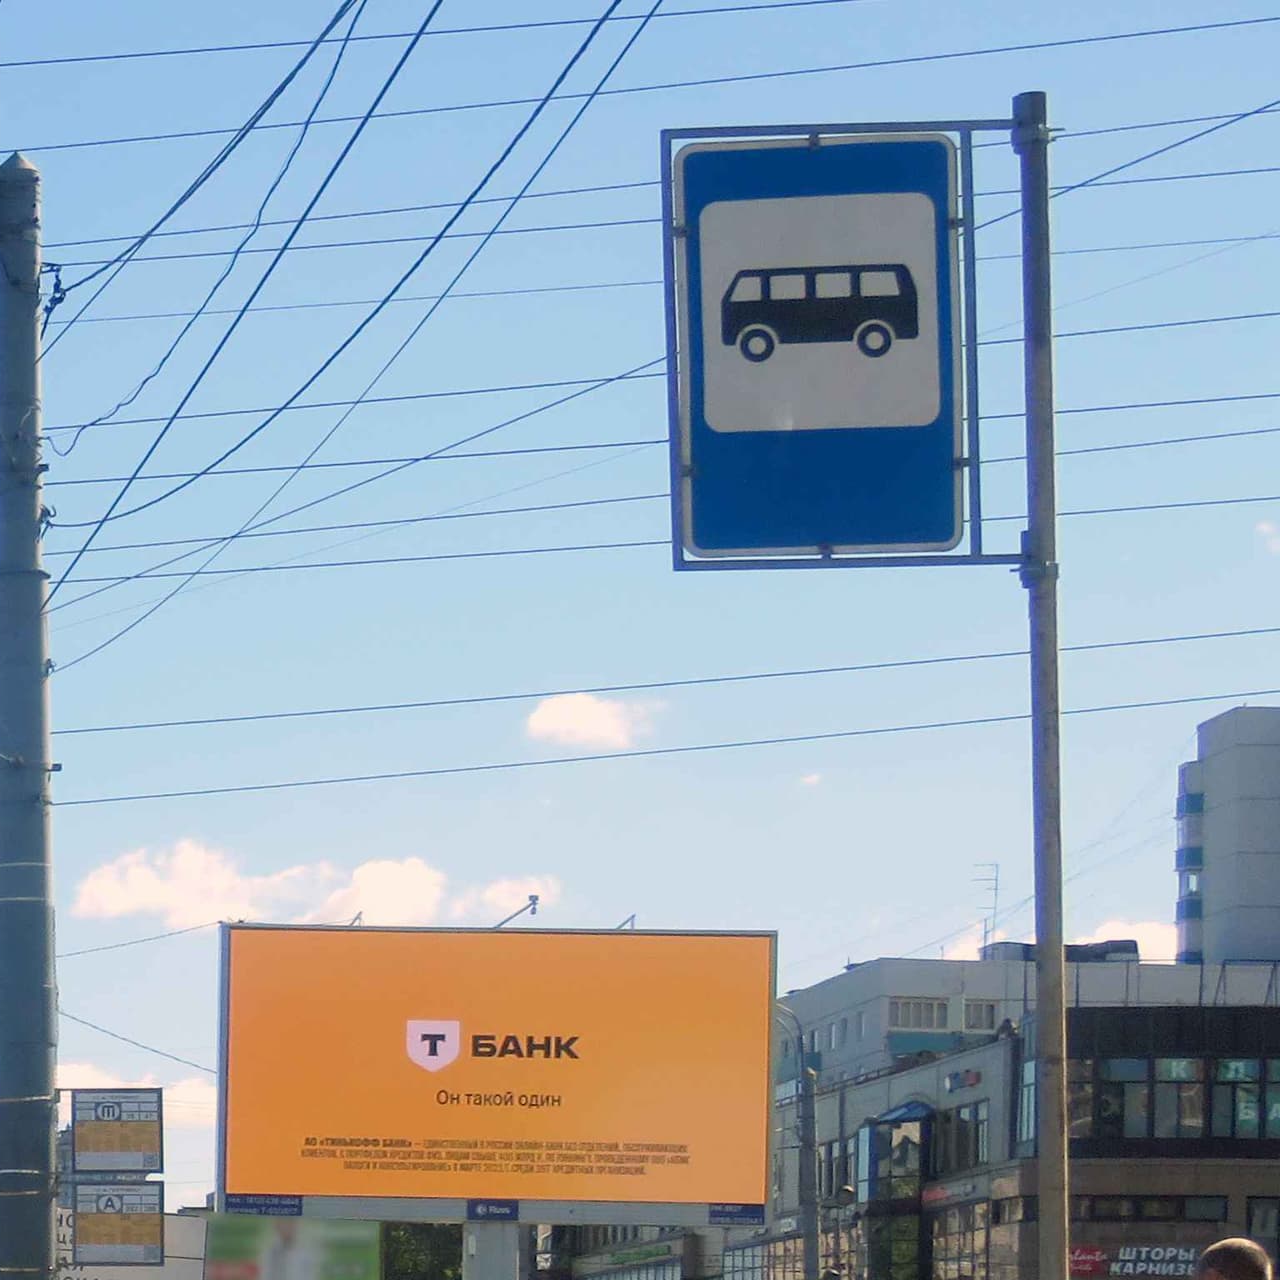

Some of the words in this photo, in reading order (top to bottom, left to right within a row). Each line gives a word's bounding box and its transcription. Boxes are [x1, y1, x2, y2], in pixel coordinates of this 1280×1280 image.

[420, 1033, 446, 1057] Т
[471, 1034, 580, 1059] БАНК
[436, 1089, 460, 1105] Он
[464, 1091, 514, 1106] такой
[517, 1093, 562, 1108] один
[103, 1196, 116, 1211] А
[1118, 1247, 1195, 1261] ШТОРЫ
